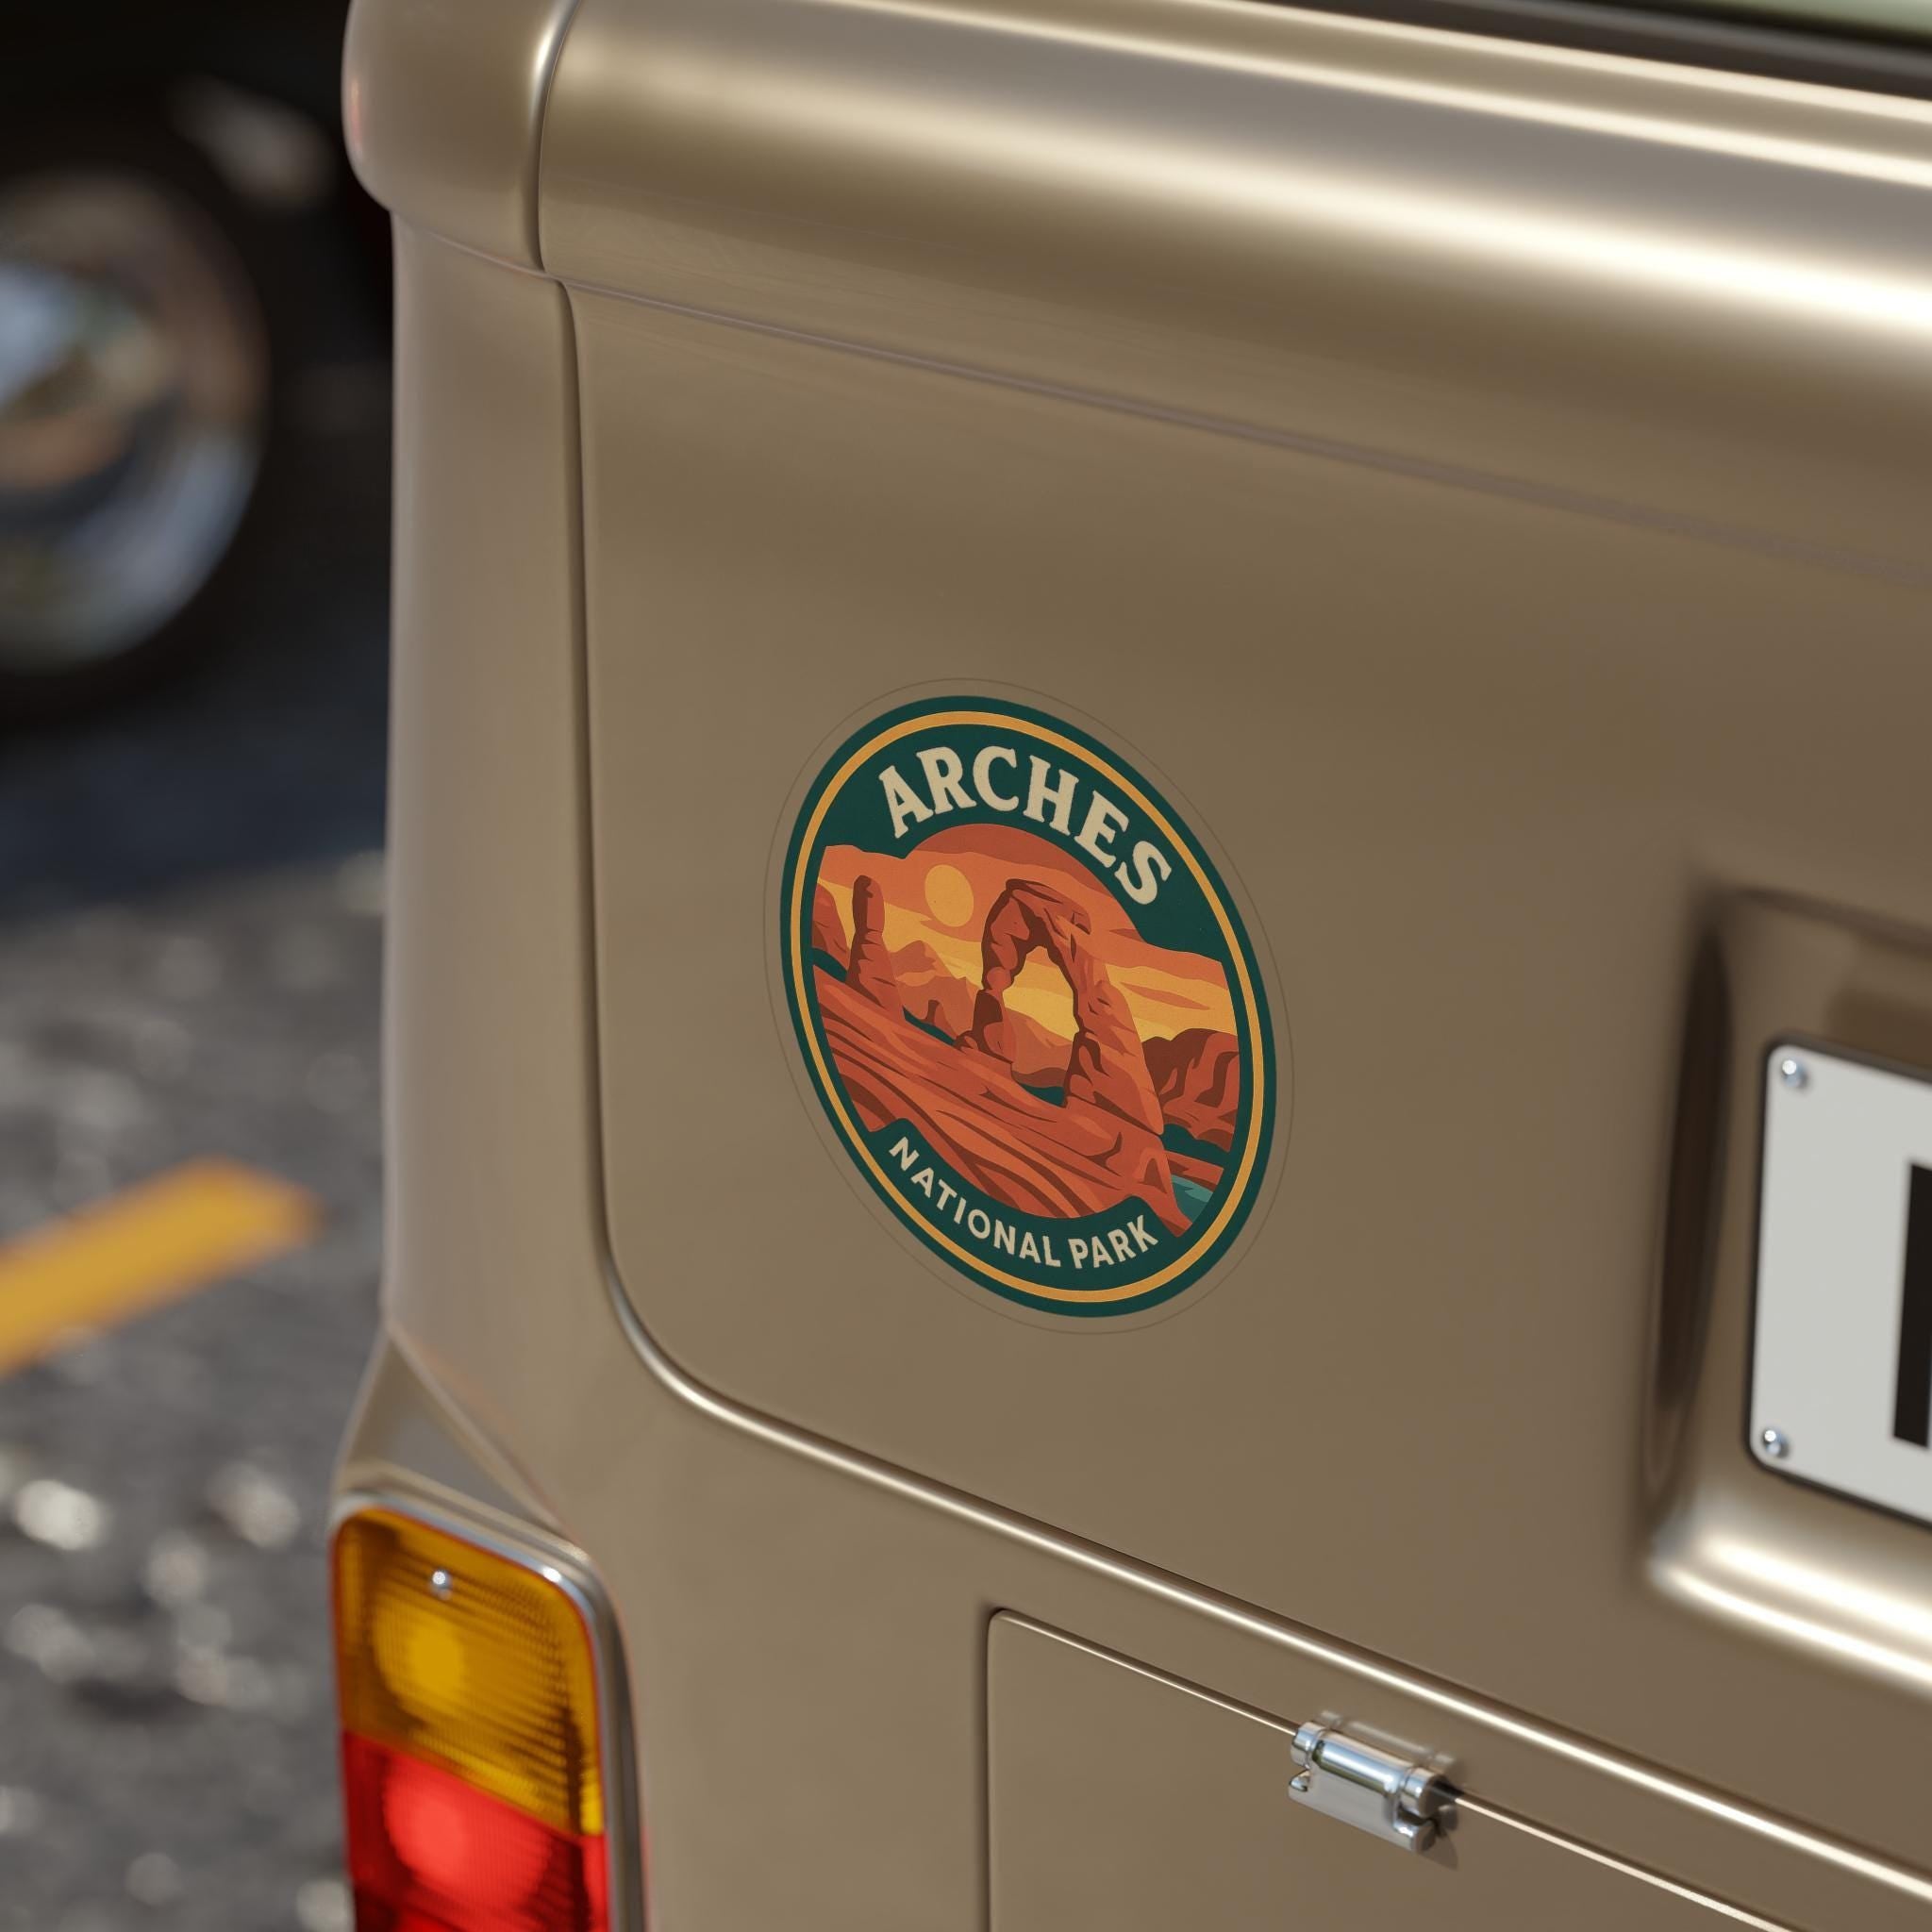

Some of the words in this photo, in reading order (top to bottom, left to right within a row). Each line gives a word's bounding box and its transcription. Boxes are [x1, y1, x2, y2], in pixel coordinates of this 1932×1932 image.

[878, 745, 1172, 906] ARCHES
[889, 1136, 1061, 1267] NATIONAL
[1068, 1214, 1159, 1270] PARK
